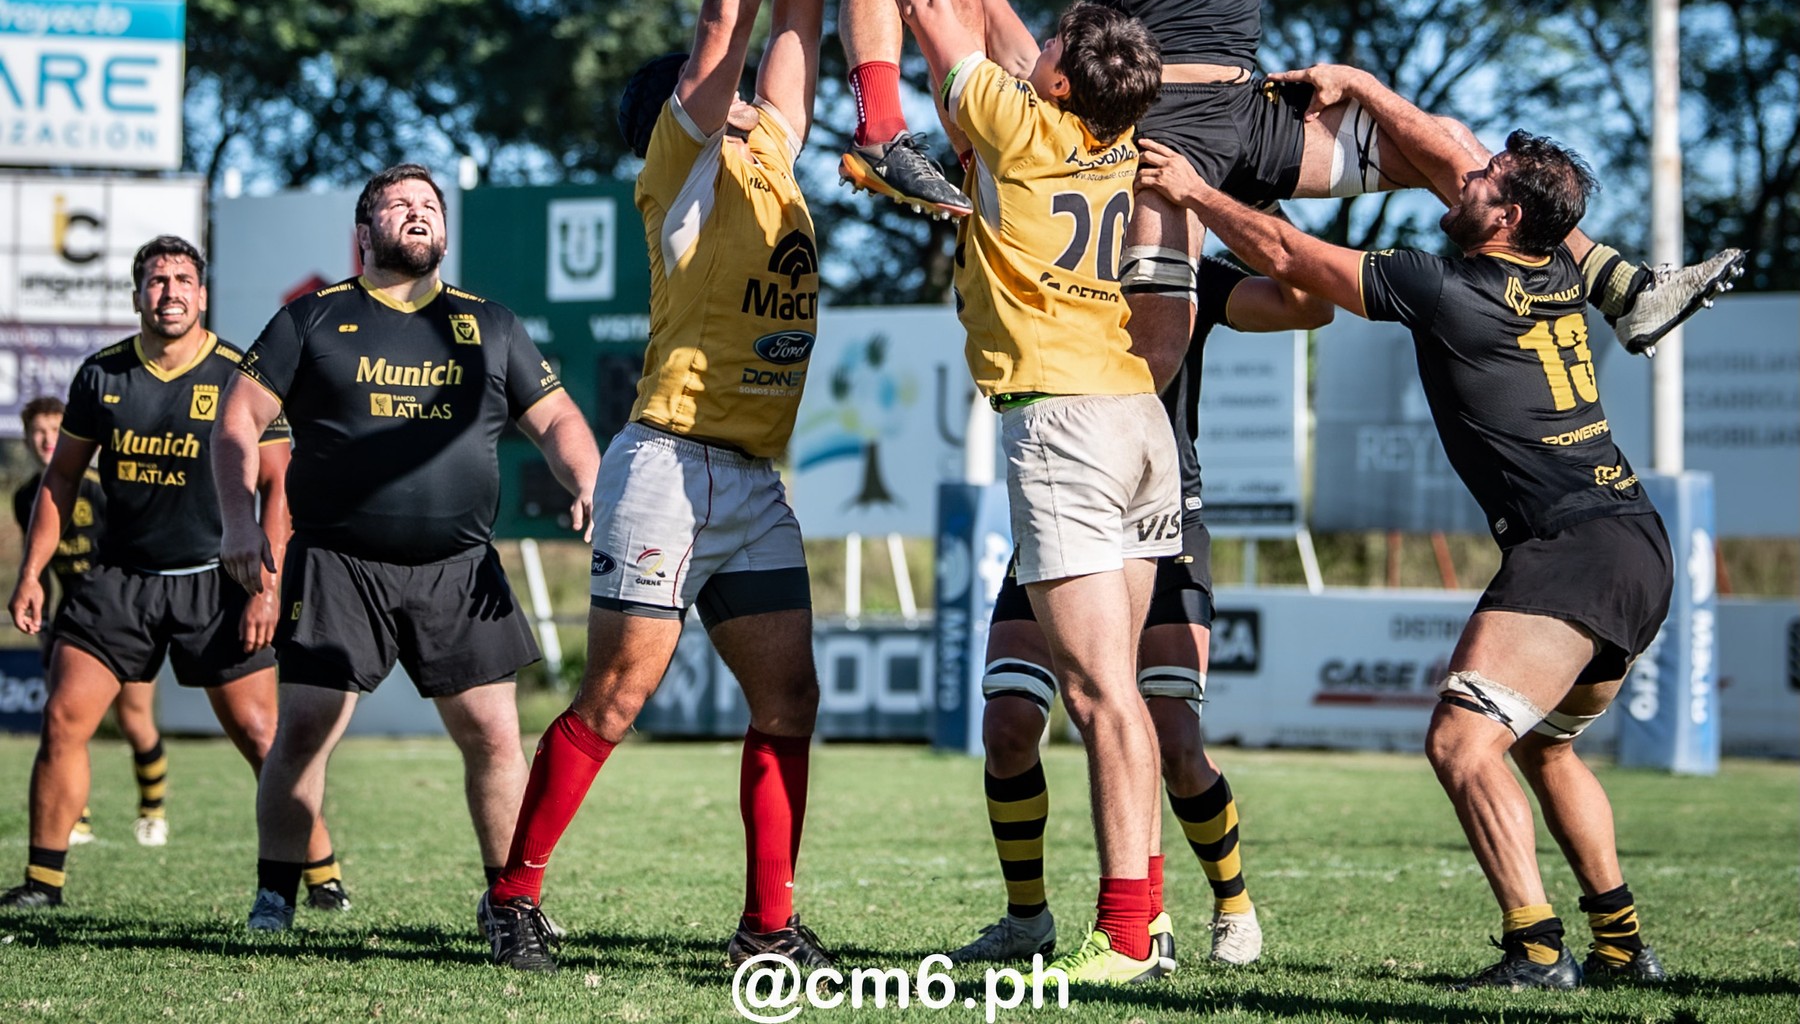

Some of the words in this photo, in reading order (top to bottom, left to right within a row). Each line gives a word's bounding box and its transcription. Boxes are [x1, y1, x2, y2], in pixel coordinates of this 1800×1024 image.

[1051, 189, 1132, 281] 20
[768, 335, 809, 358] Ford
[356, 356, 464, 387] Munich
[392, 394, 417, 403] BANCO
[394, 402, 453, 420] ATLAS
[111, 428, 201, 459] Munich
[136, 469, 187, 487] ATLAS
[1318, 658, 1419, 688] CASE
